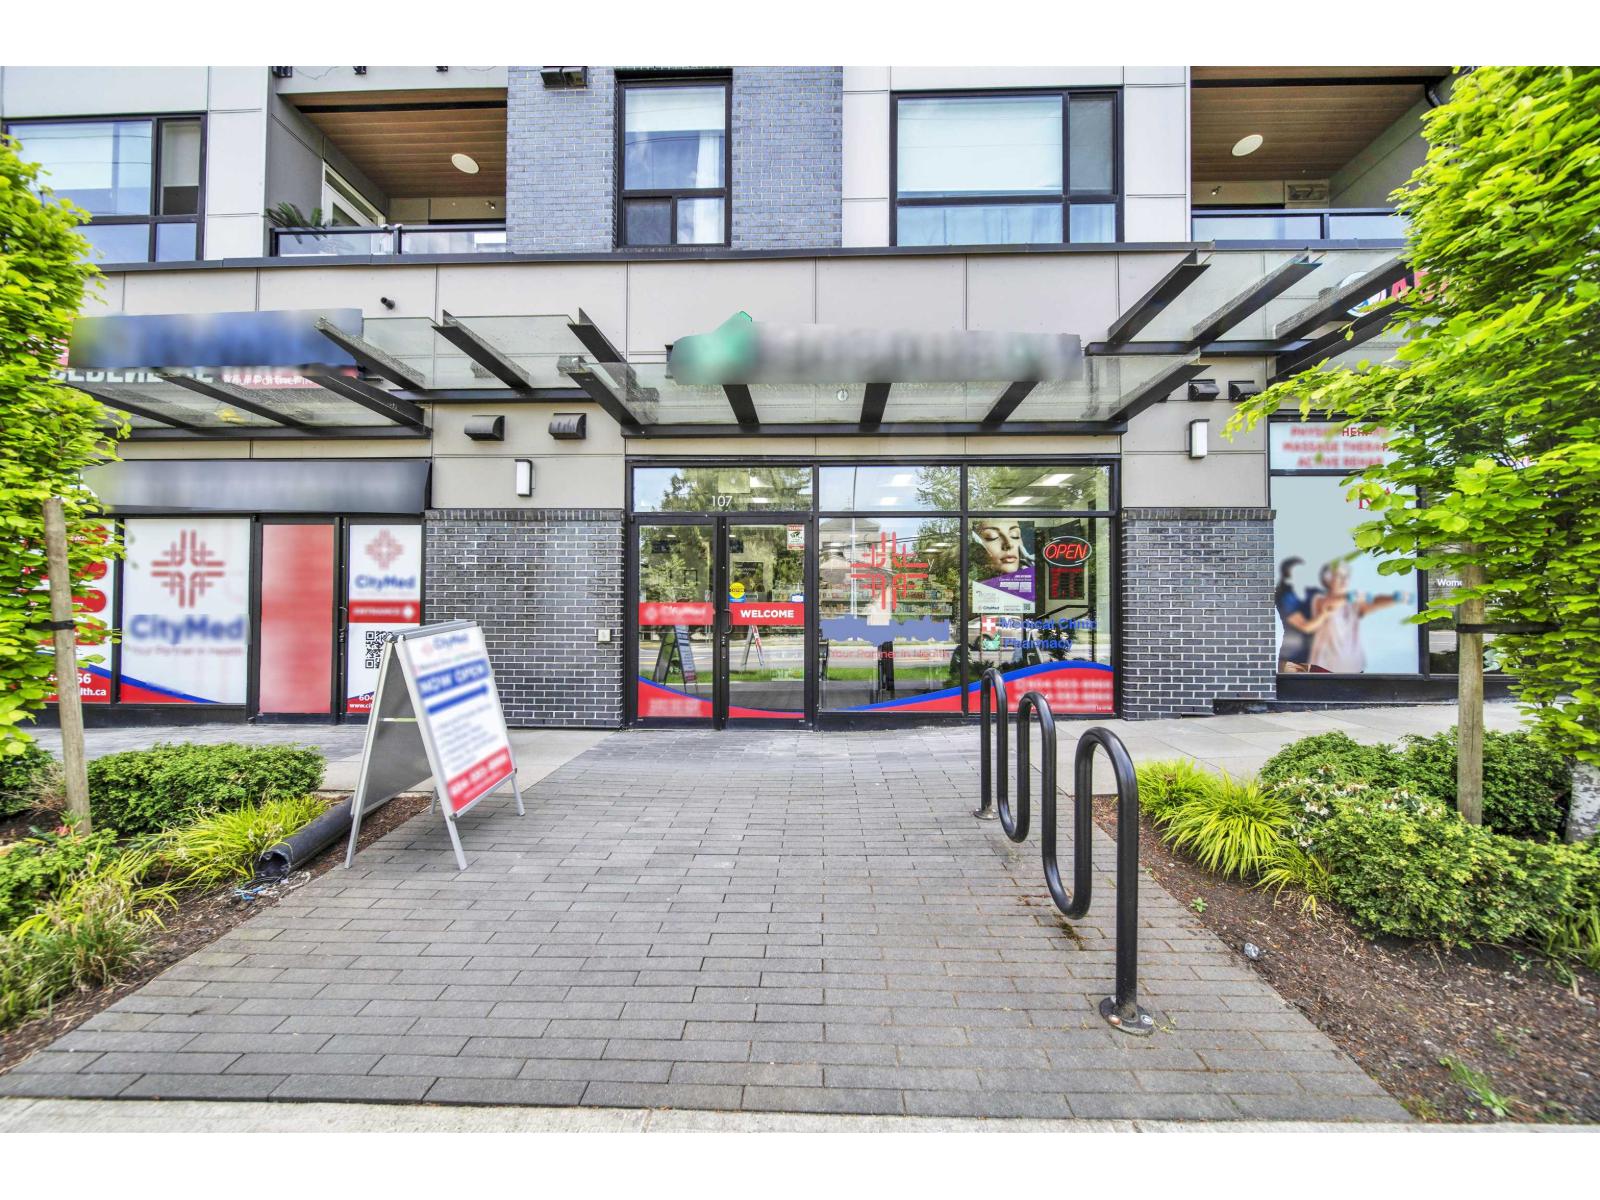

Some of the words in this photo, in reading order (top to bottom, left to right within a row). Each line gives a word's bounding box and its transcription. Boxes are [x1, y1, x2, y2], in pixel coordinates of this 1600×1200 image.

[711, 495, 733, 507] 107
[1045, 544, 1089, 559] OPEN
[740, 609, 794, 619] WELCOME
